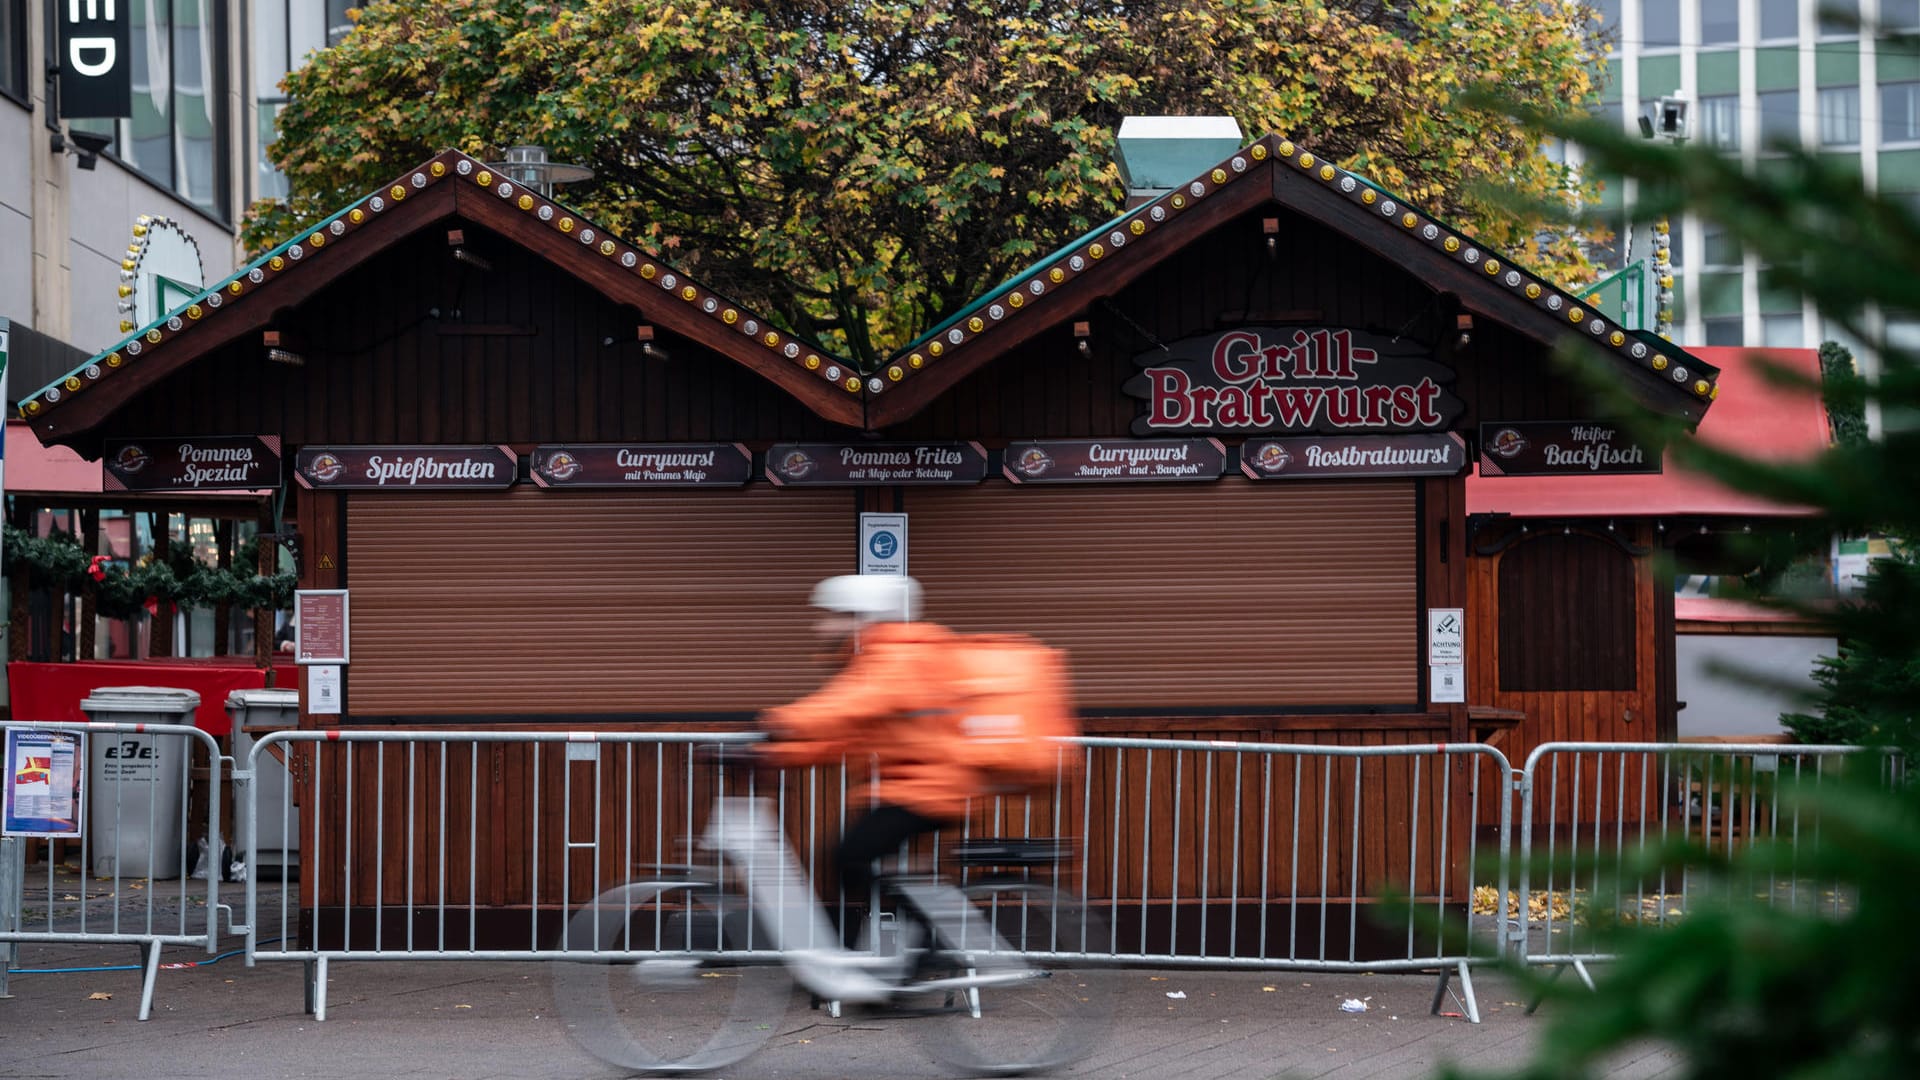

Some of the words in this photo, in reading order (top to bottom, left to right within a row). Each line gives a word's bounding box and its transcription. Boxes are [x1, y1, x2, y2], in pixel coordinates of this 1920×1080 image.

[1212, 328, 1378, 385] Grill-
[1144, 367, 1442, 428] Bratwurst
[1571, 426, 1616, 445] Heißer
[178, 443, 253, 463] Pommes
[616, 448, 715, 472] Currywurst
[840, 447, 911, 465] Pommes
[914, 447, 963, 465] Frites
[1089, 444, 1189, 467] Currywurst
[1305, 444, 1450, 468] Rostbratwurst
[1543, 443, 1644, 472] Backfisch
[365, 455, 495, 486] Spießbraten
[624, 470, 642, 480] mit
[643, 470, 681, 481] Pommes
[682, 469, 707, 483] Majo
[849, 468, 866, 479] mit
[867, 468, 891, 481] Majo
[892, 468, 914, 478] oder
[915, 467, 953, 480] Ketchup
[1129, 464, 1148, 475] und
